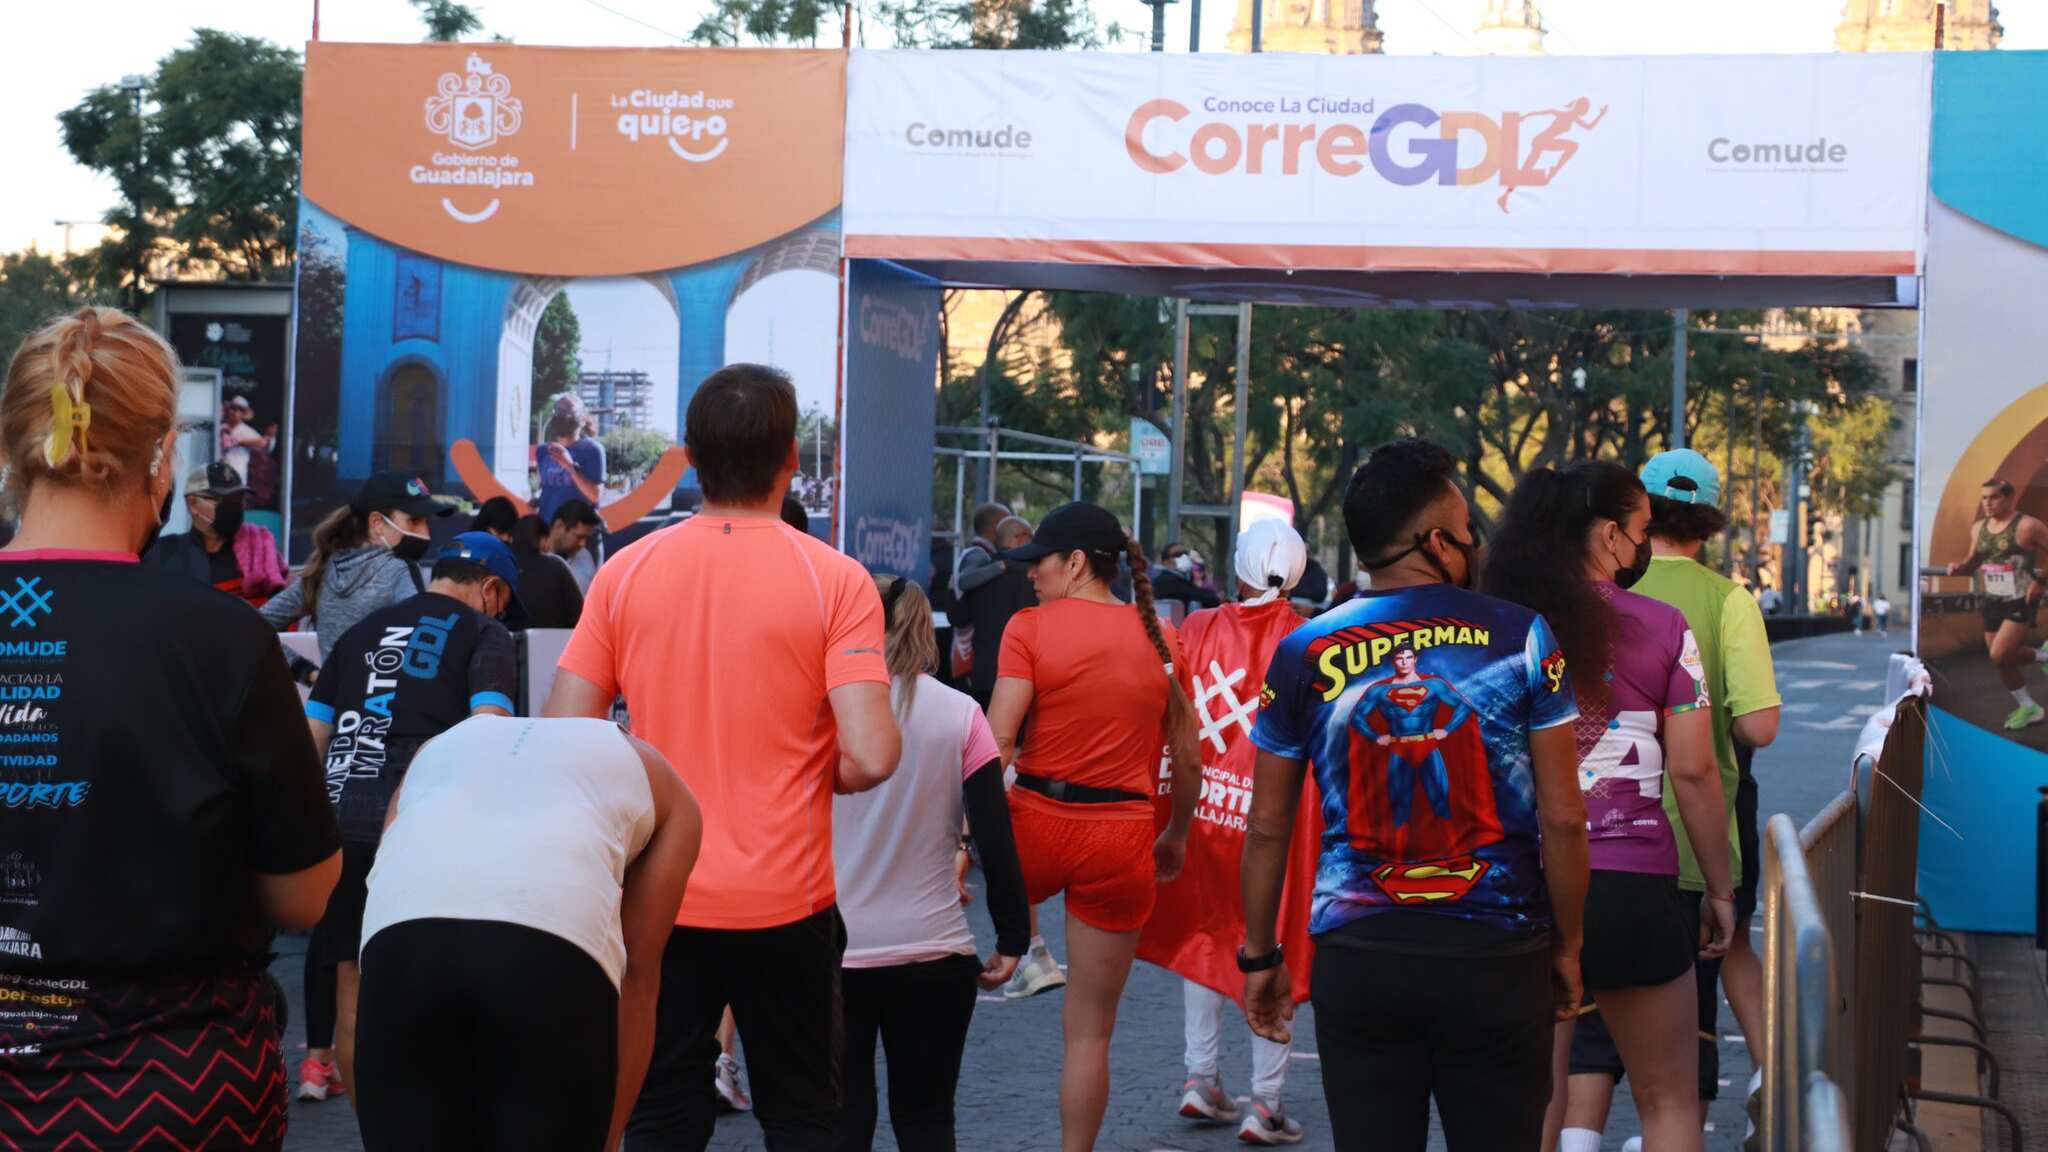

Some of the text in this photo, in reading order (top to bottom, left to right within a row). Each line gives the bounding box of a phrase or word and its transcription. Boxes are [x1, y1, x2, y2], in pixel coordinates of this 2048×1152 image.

[611, 89, 736, 111] La Ciudad que
[1203, 97, 1375, 115] Conoce La Ciudad
[617, 107, 727, 142] quiero
[905, 121, 1033, 149] Comude
[432, 152, 519, 167] Gobierno de
[1707, 137, 1848, 163] Comude
[410, 164, 534, 189] Guadalajara
[402, 612, 460, 680] GDL
[1319, 625, 1489, 702] SUPERMAN
